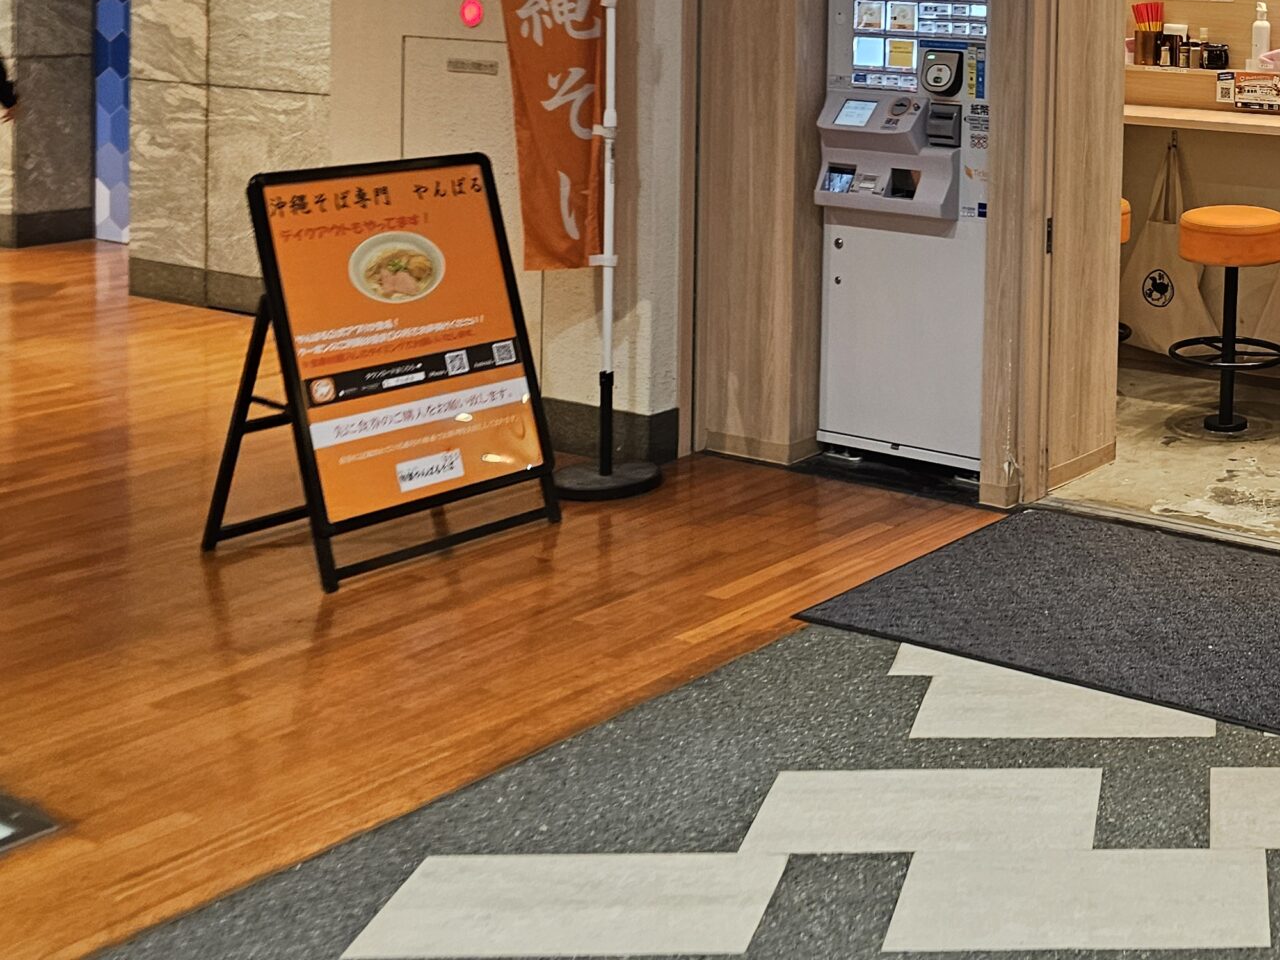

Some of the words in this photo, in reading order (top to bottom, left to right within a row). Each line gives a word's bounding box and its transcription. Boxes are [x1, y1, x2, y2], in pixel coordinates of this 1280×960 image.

[269, 185, 392, 218] 沖縄そば専門
[413, 176, 484, 200] やんばる
